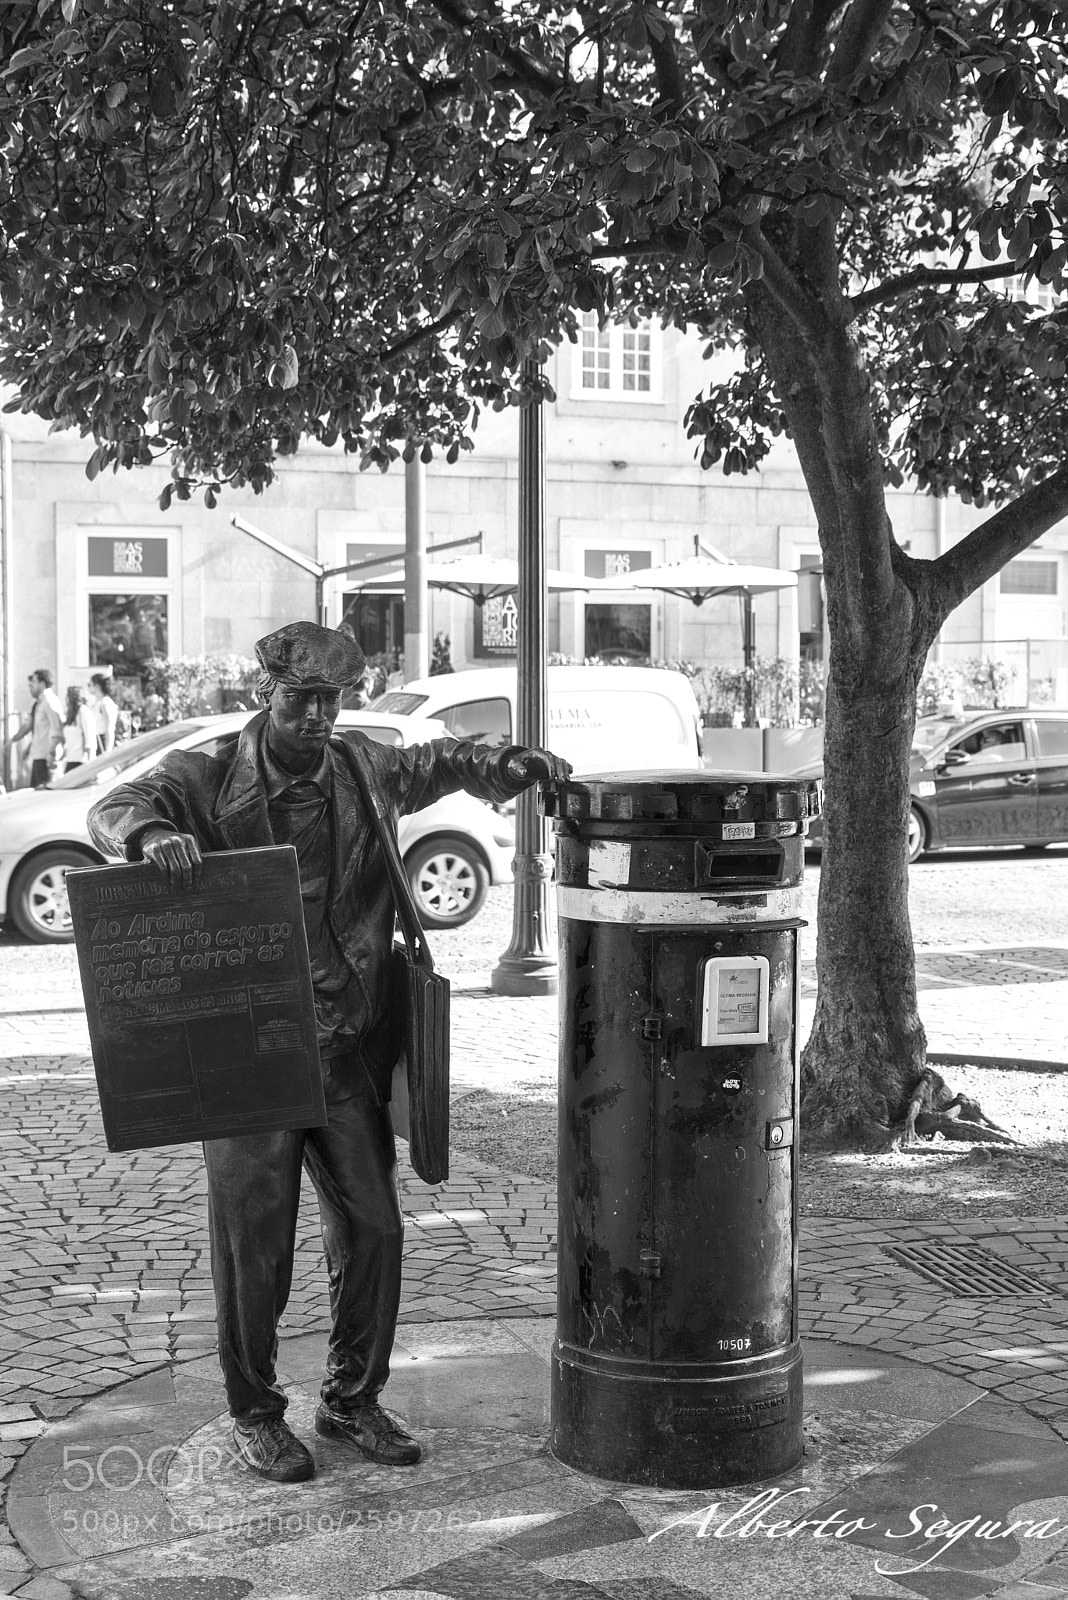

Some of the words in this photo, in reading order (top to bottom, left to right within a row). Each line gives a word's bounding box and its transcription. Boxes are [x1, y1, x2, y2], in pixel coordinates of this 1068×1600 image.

[91, 917, 121, 941] Ao
[128, 911, 205, 937] Ardina
[183, 930, 211, 950] do
[215, 922, 292, 944] esforço
[95, 960, 136, 985] que
[141, 955, 175, 980] faz
[180, 948, 253, 971] correr
[257, 943, 284, 962] as
[717, 1338, 751, 1351] 10507
